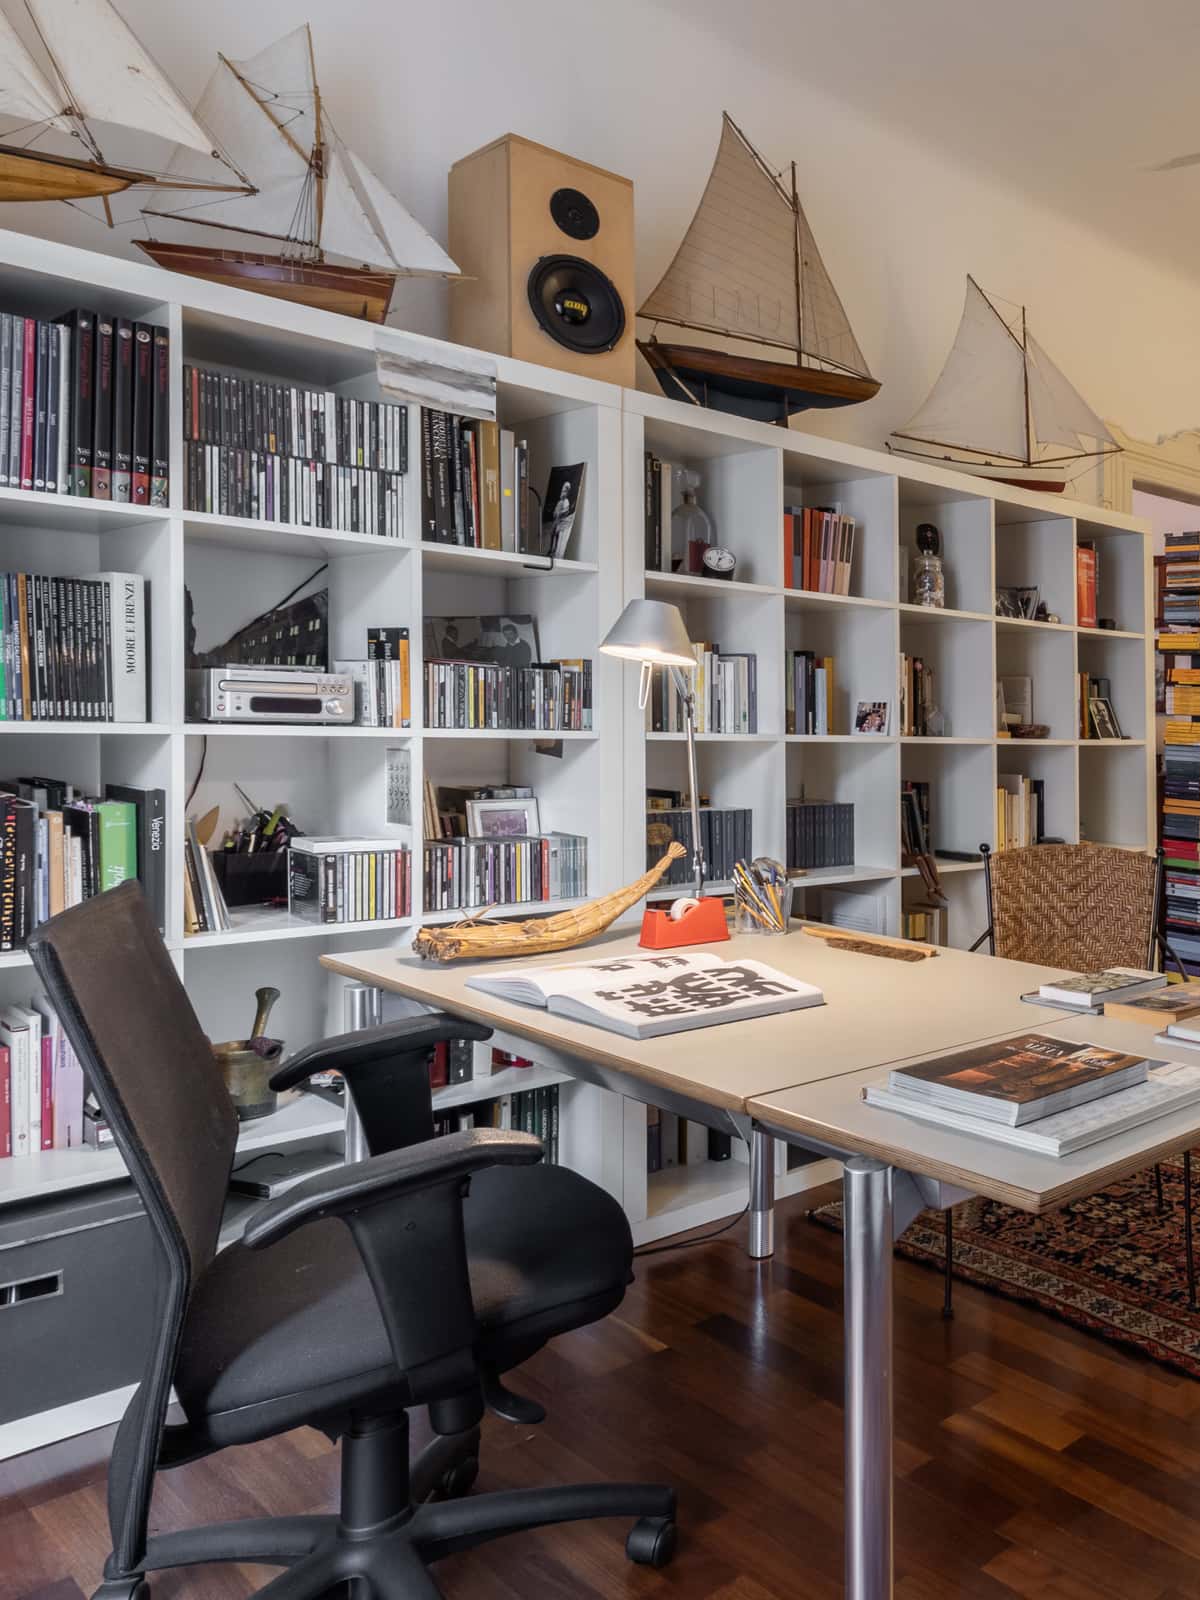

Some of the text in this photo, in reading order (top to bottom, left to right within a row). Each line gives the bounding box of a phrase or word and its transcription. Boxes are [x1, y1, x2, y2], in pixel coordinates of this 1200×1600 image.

[124, 580, 135, 623] FIRENZE
[125, 634, 136, 674] MOORE
[151, 816, 164, 851] Venezia
[458, 1068, 464, 1077] 1
